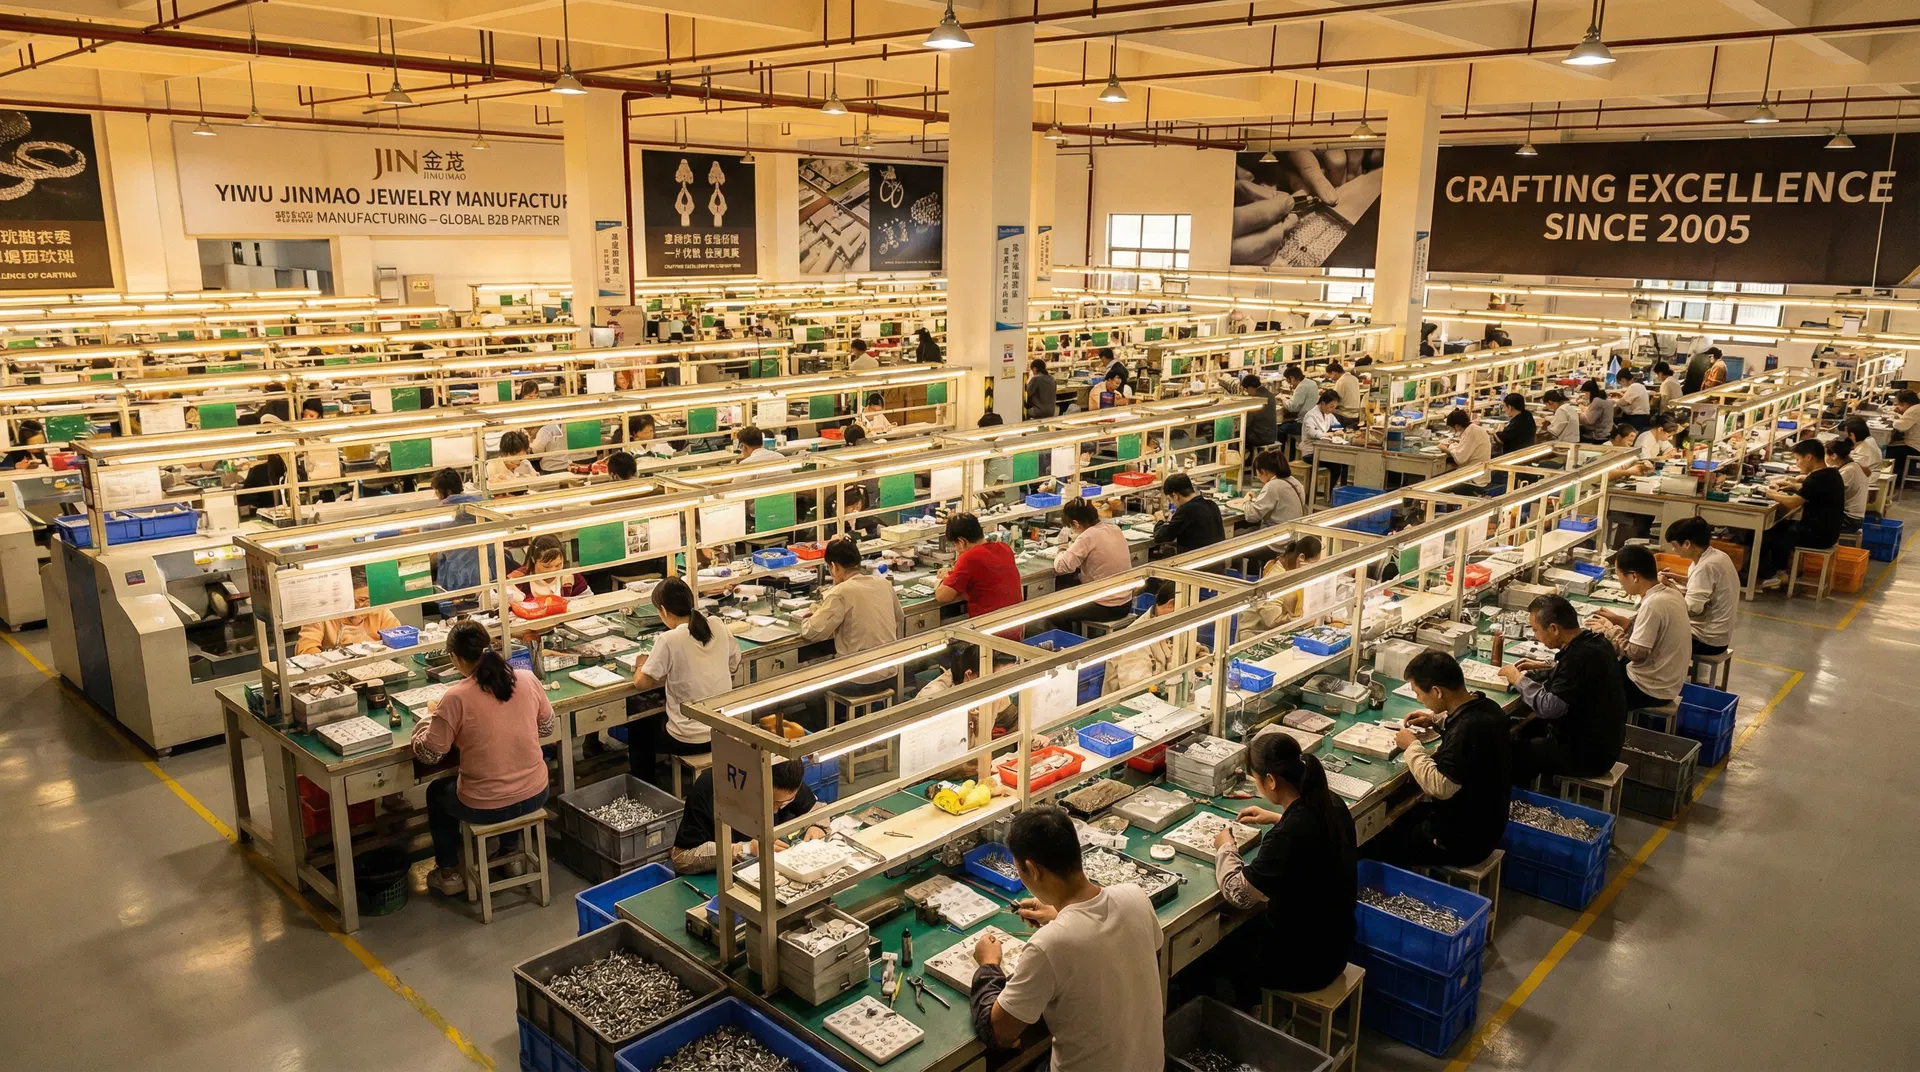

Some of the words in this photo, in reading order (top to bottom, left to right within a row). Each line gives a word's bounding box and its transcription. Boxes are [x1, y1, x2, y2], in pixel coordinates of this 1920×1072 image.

[371, 148, 418, 181] JIN
[215, 184, 273, 203] YIWU
[280, 186, 361, 205] JINMAO
[366, 188, 451, 206] JEWELRY
[1445, 173, 1616, 203] CRAFTING
[1627, 170, 1897, 203] EXCELLENCE
[317, 211, 427, 225] MANUFACTURING
[439, 213, 485, 226] GLOBAL
[487, 214, 509, 226] B2B
[511, 214, 560, 226] PARTNER
[1543, 212, 1649, 242] SINCE
[1656, 213, 1750, 244] 2005
[727, 763, 748, 791] R7
